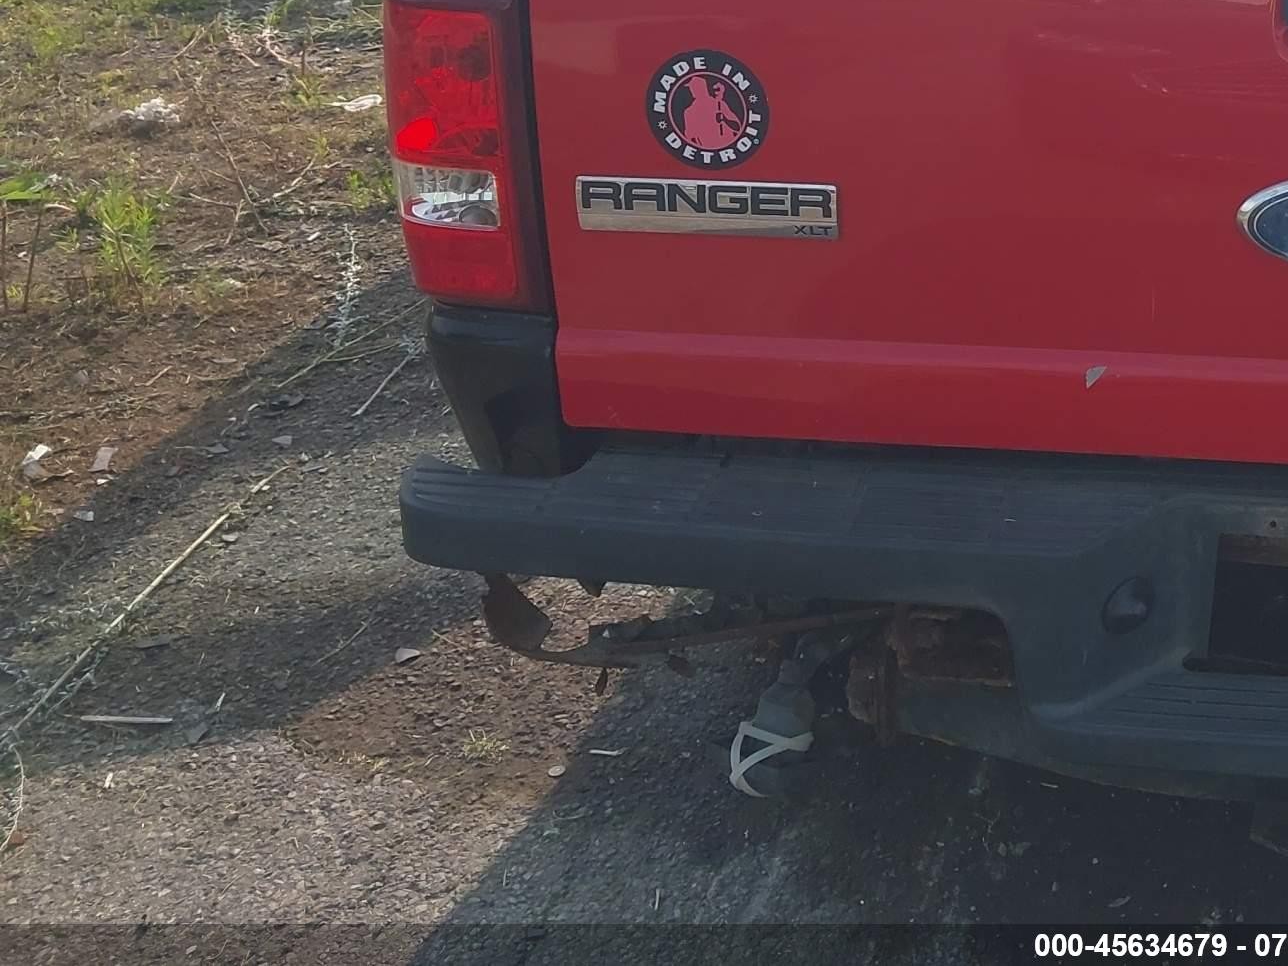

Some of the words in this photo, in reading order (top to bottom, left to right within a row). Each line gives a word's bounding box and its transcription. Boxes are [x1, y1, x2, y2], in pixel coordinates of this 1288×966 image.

[654, 57, 706, 114] MADE
[722, 64, 750, 91] IN
[664, 110, 760, 163] DETROIT
[581, 181, 832, 218] RANGER
[794, 226, 832, 236] XLT
